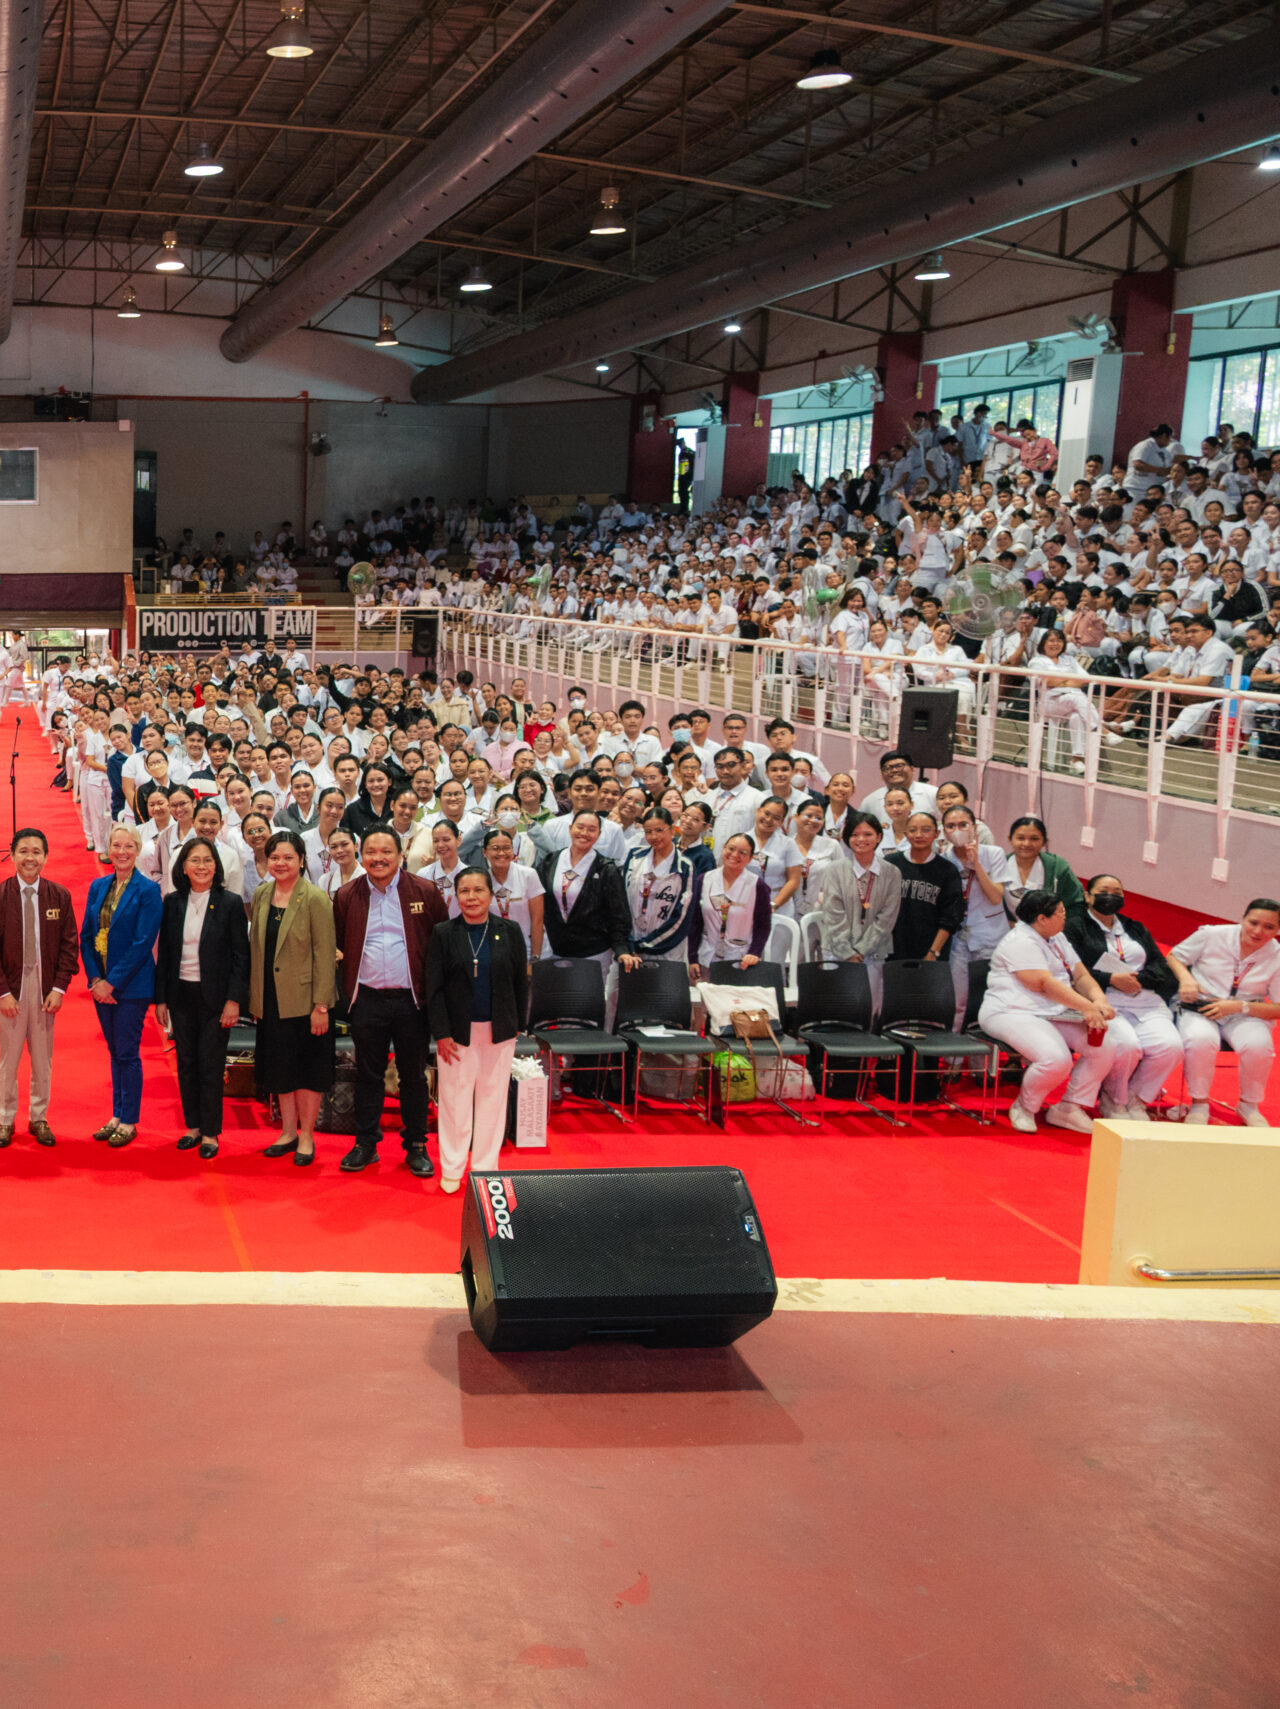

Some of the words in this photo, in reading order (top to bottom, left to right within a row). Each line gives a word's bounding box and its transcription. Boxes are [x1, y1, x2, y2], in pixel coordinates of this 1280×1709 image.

[142, 611, 257, 637] PRODUCTION
[262, 610, 313, 636] TEAM
[46, 908, 61, 918] CIT
[526, 1087, 535, 1137] MALASAKIT
[487, 1180, 514, 1240] 2000
